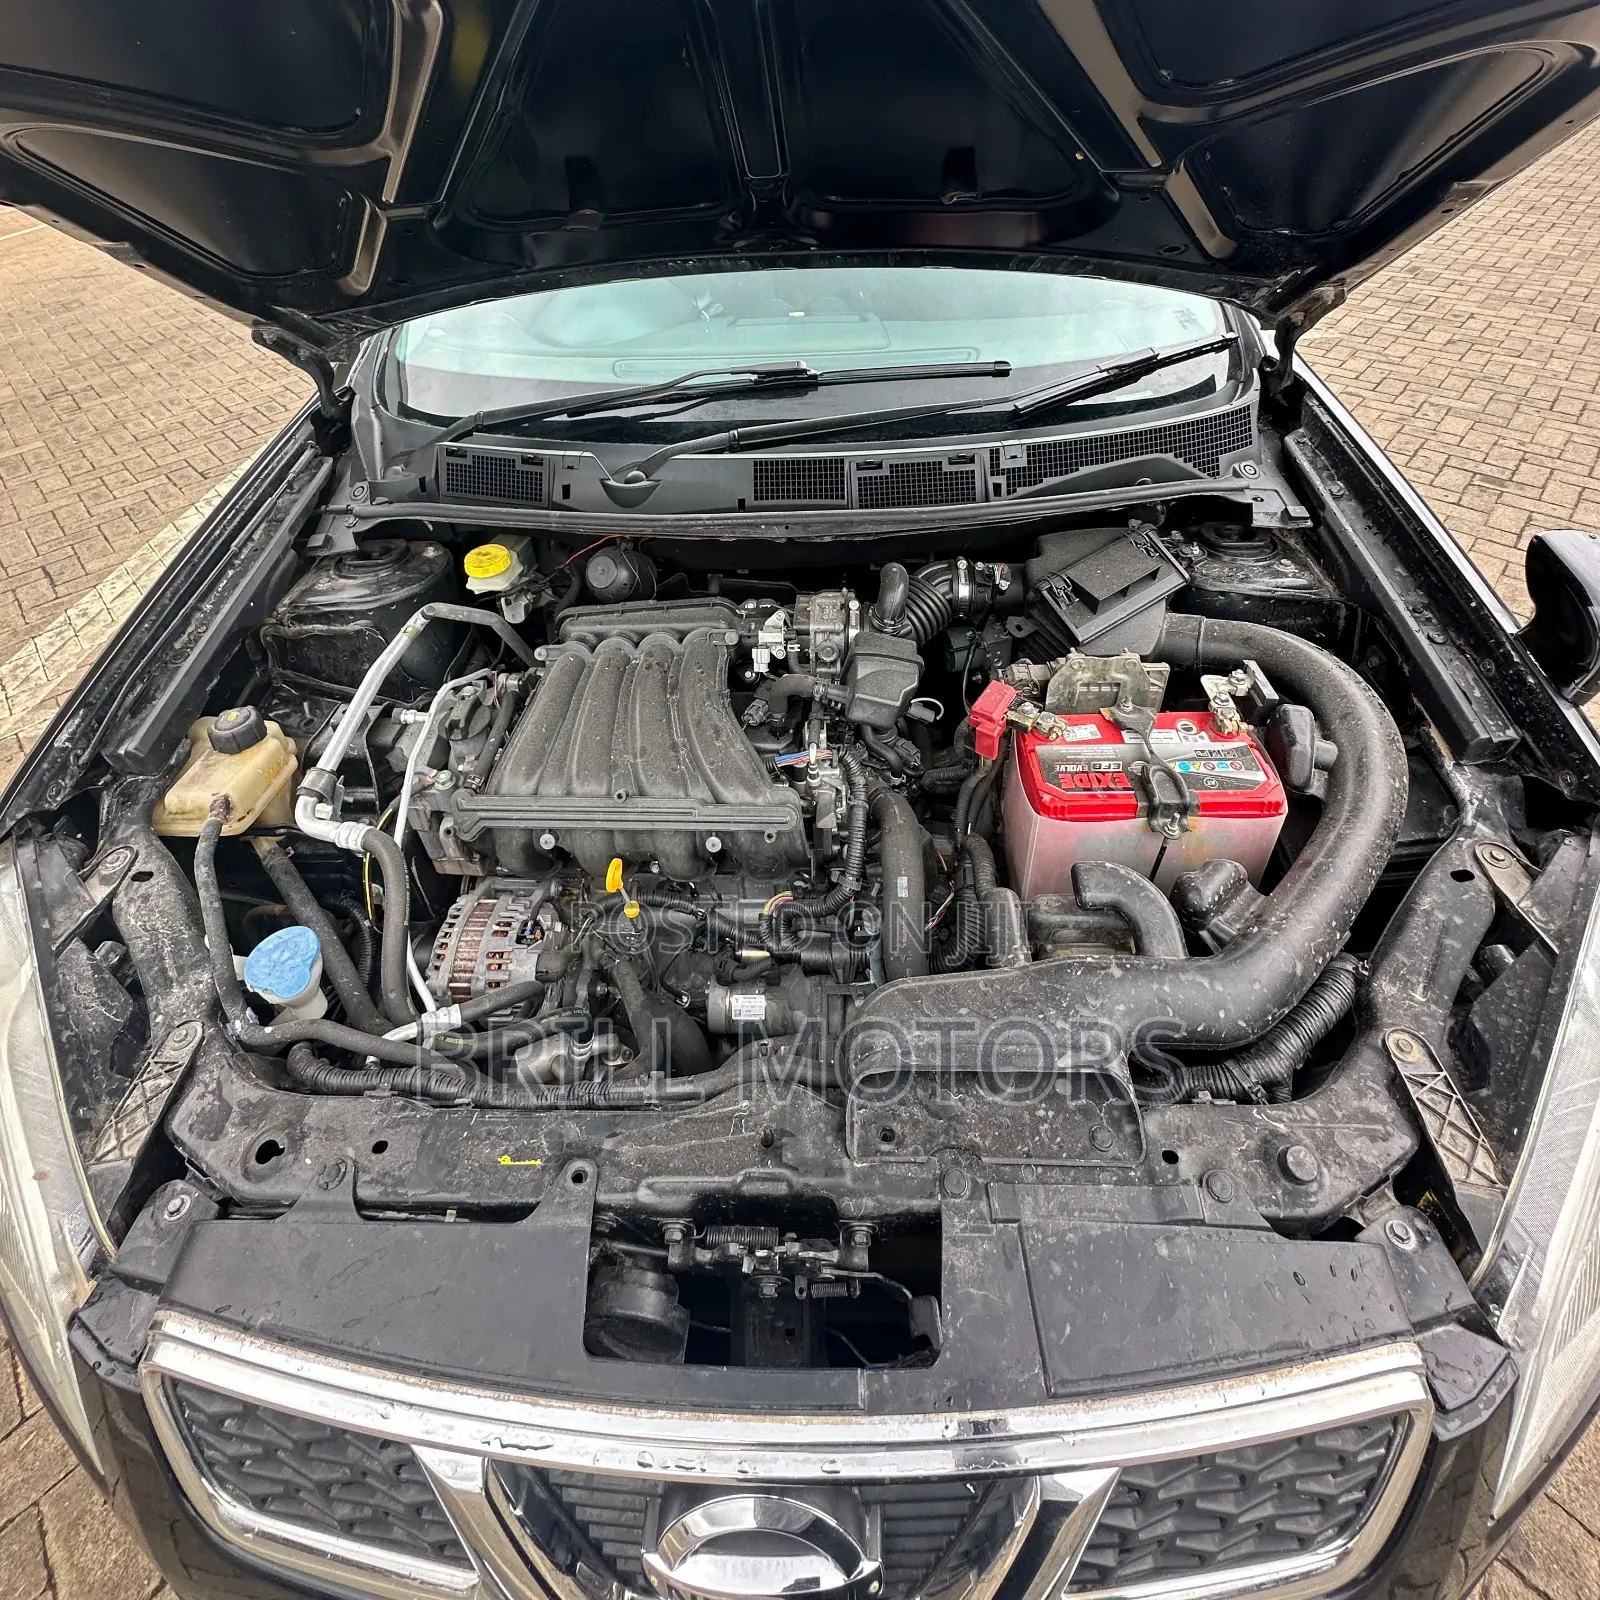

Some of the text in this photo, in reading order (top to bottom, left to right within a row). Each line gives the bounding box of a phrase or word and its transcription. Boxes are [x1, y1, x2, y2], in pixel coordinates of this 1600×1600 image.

[1054, 764, 1089, 772] EVOLVE
[1092, 762, 1122, 771] EFB
[1058, 772, 1131, 789] EXIDE
